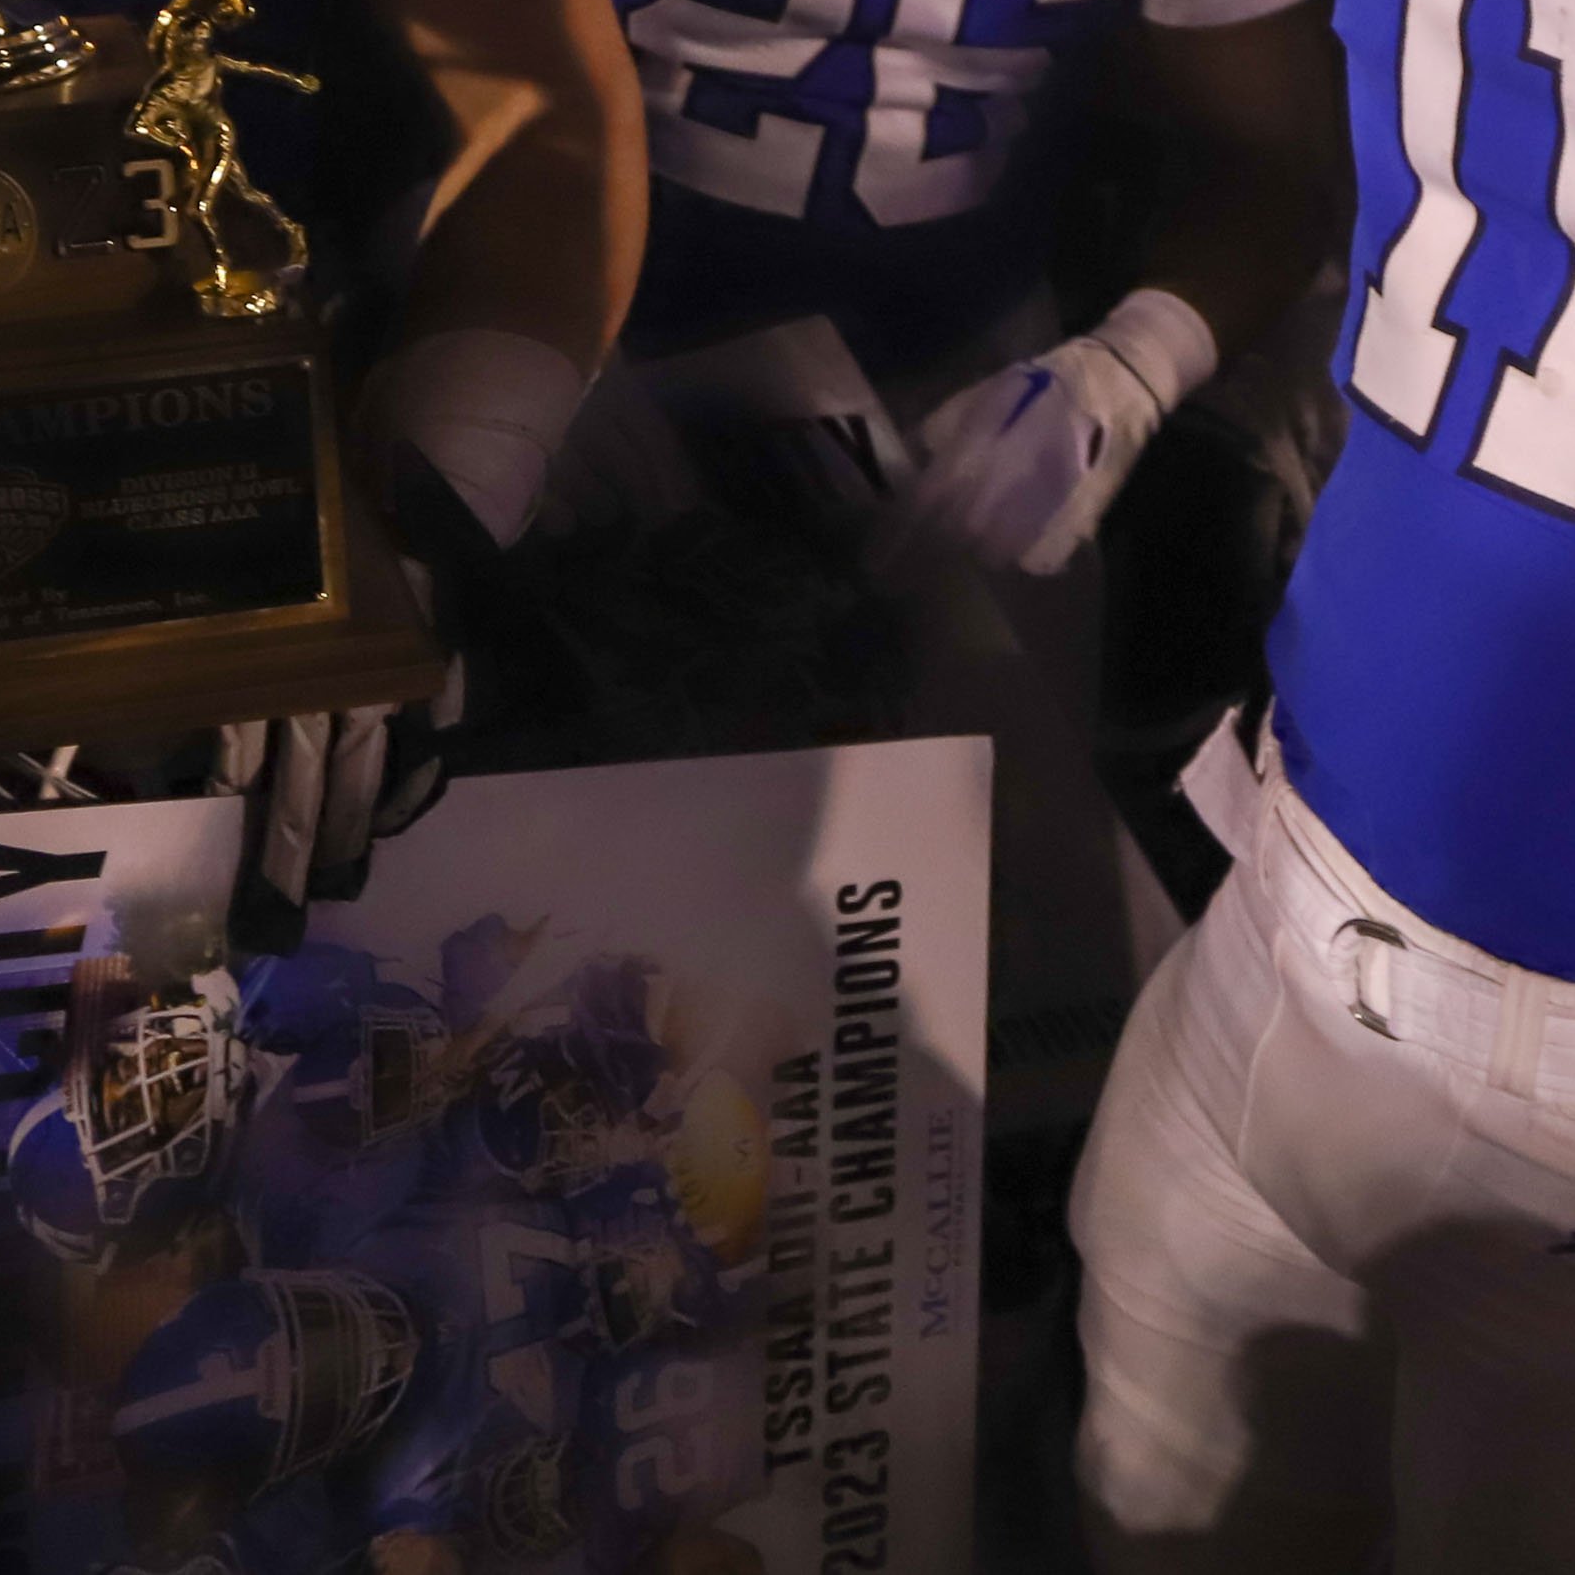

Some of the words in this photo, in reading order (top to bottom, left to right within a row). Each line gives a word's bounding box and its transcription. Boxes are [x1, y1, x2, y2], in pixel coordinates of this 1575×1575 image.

[830, 878, 903, 1226] CHAMPIONS
[762, 1293, 815, 1480] TSSAA
[826, 1237, 895, 1415] STATE
